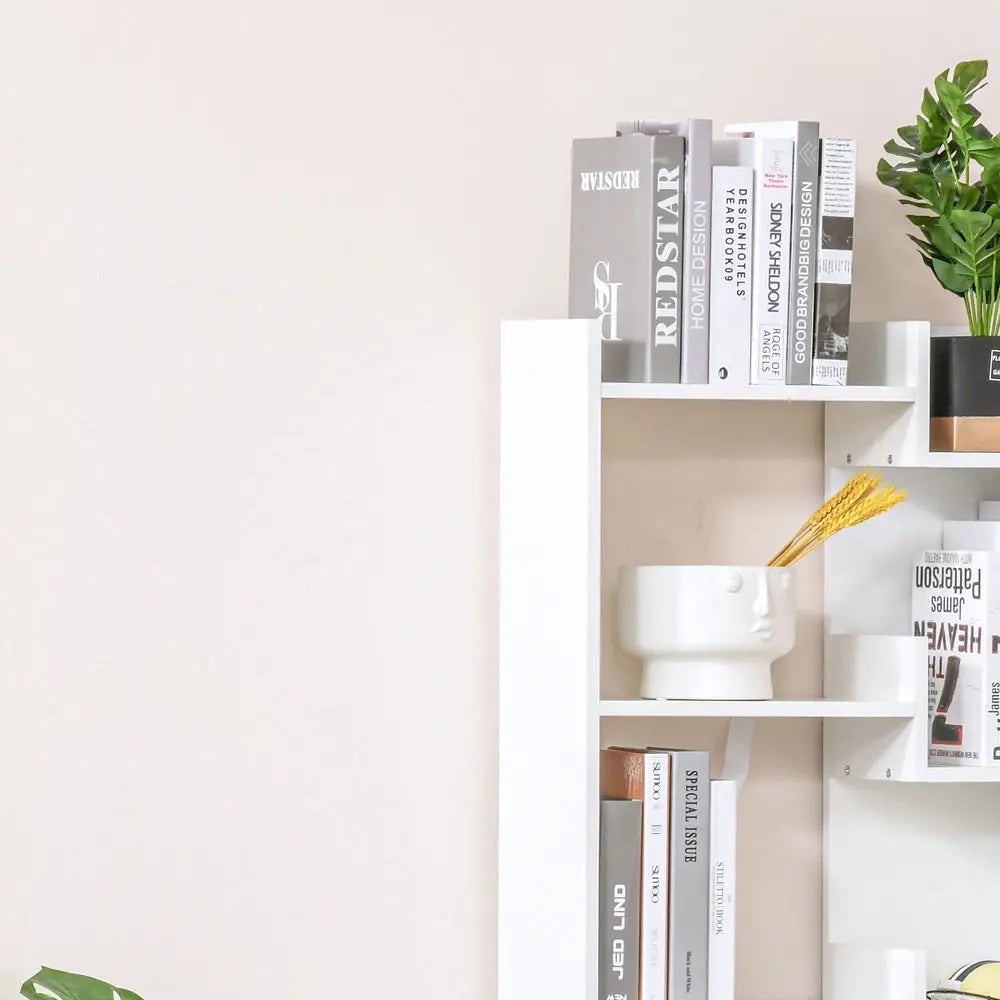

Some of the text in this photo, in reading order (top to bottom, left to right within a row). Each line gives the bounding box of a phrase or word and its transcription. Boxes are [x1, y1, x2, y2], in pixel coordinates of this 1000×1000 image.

[580, 169, 640, 191] REDSTAR
[655, 165, 680, 348] REDSTAR
[767, 203, 783, 313] SIDNEY SHELDON
[690, 275, 706, 329] HOME
[761, 330, 771, 373] ANGELS
[771, 361, 780, 376] OF
[915, 566, 981, 599] Patterson
[931, 595, 965, 620] James
[988, 682, 1000, 716] James
[684, 770, 698, 864] SPECIAL ISSUE
[715, 861, 724, 936] STILETTO BOOK
[612, 884, 626, 980] JED LIND
